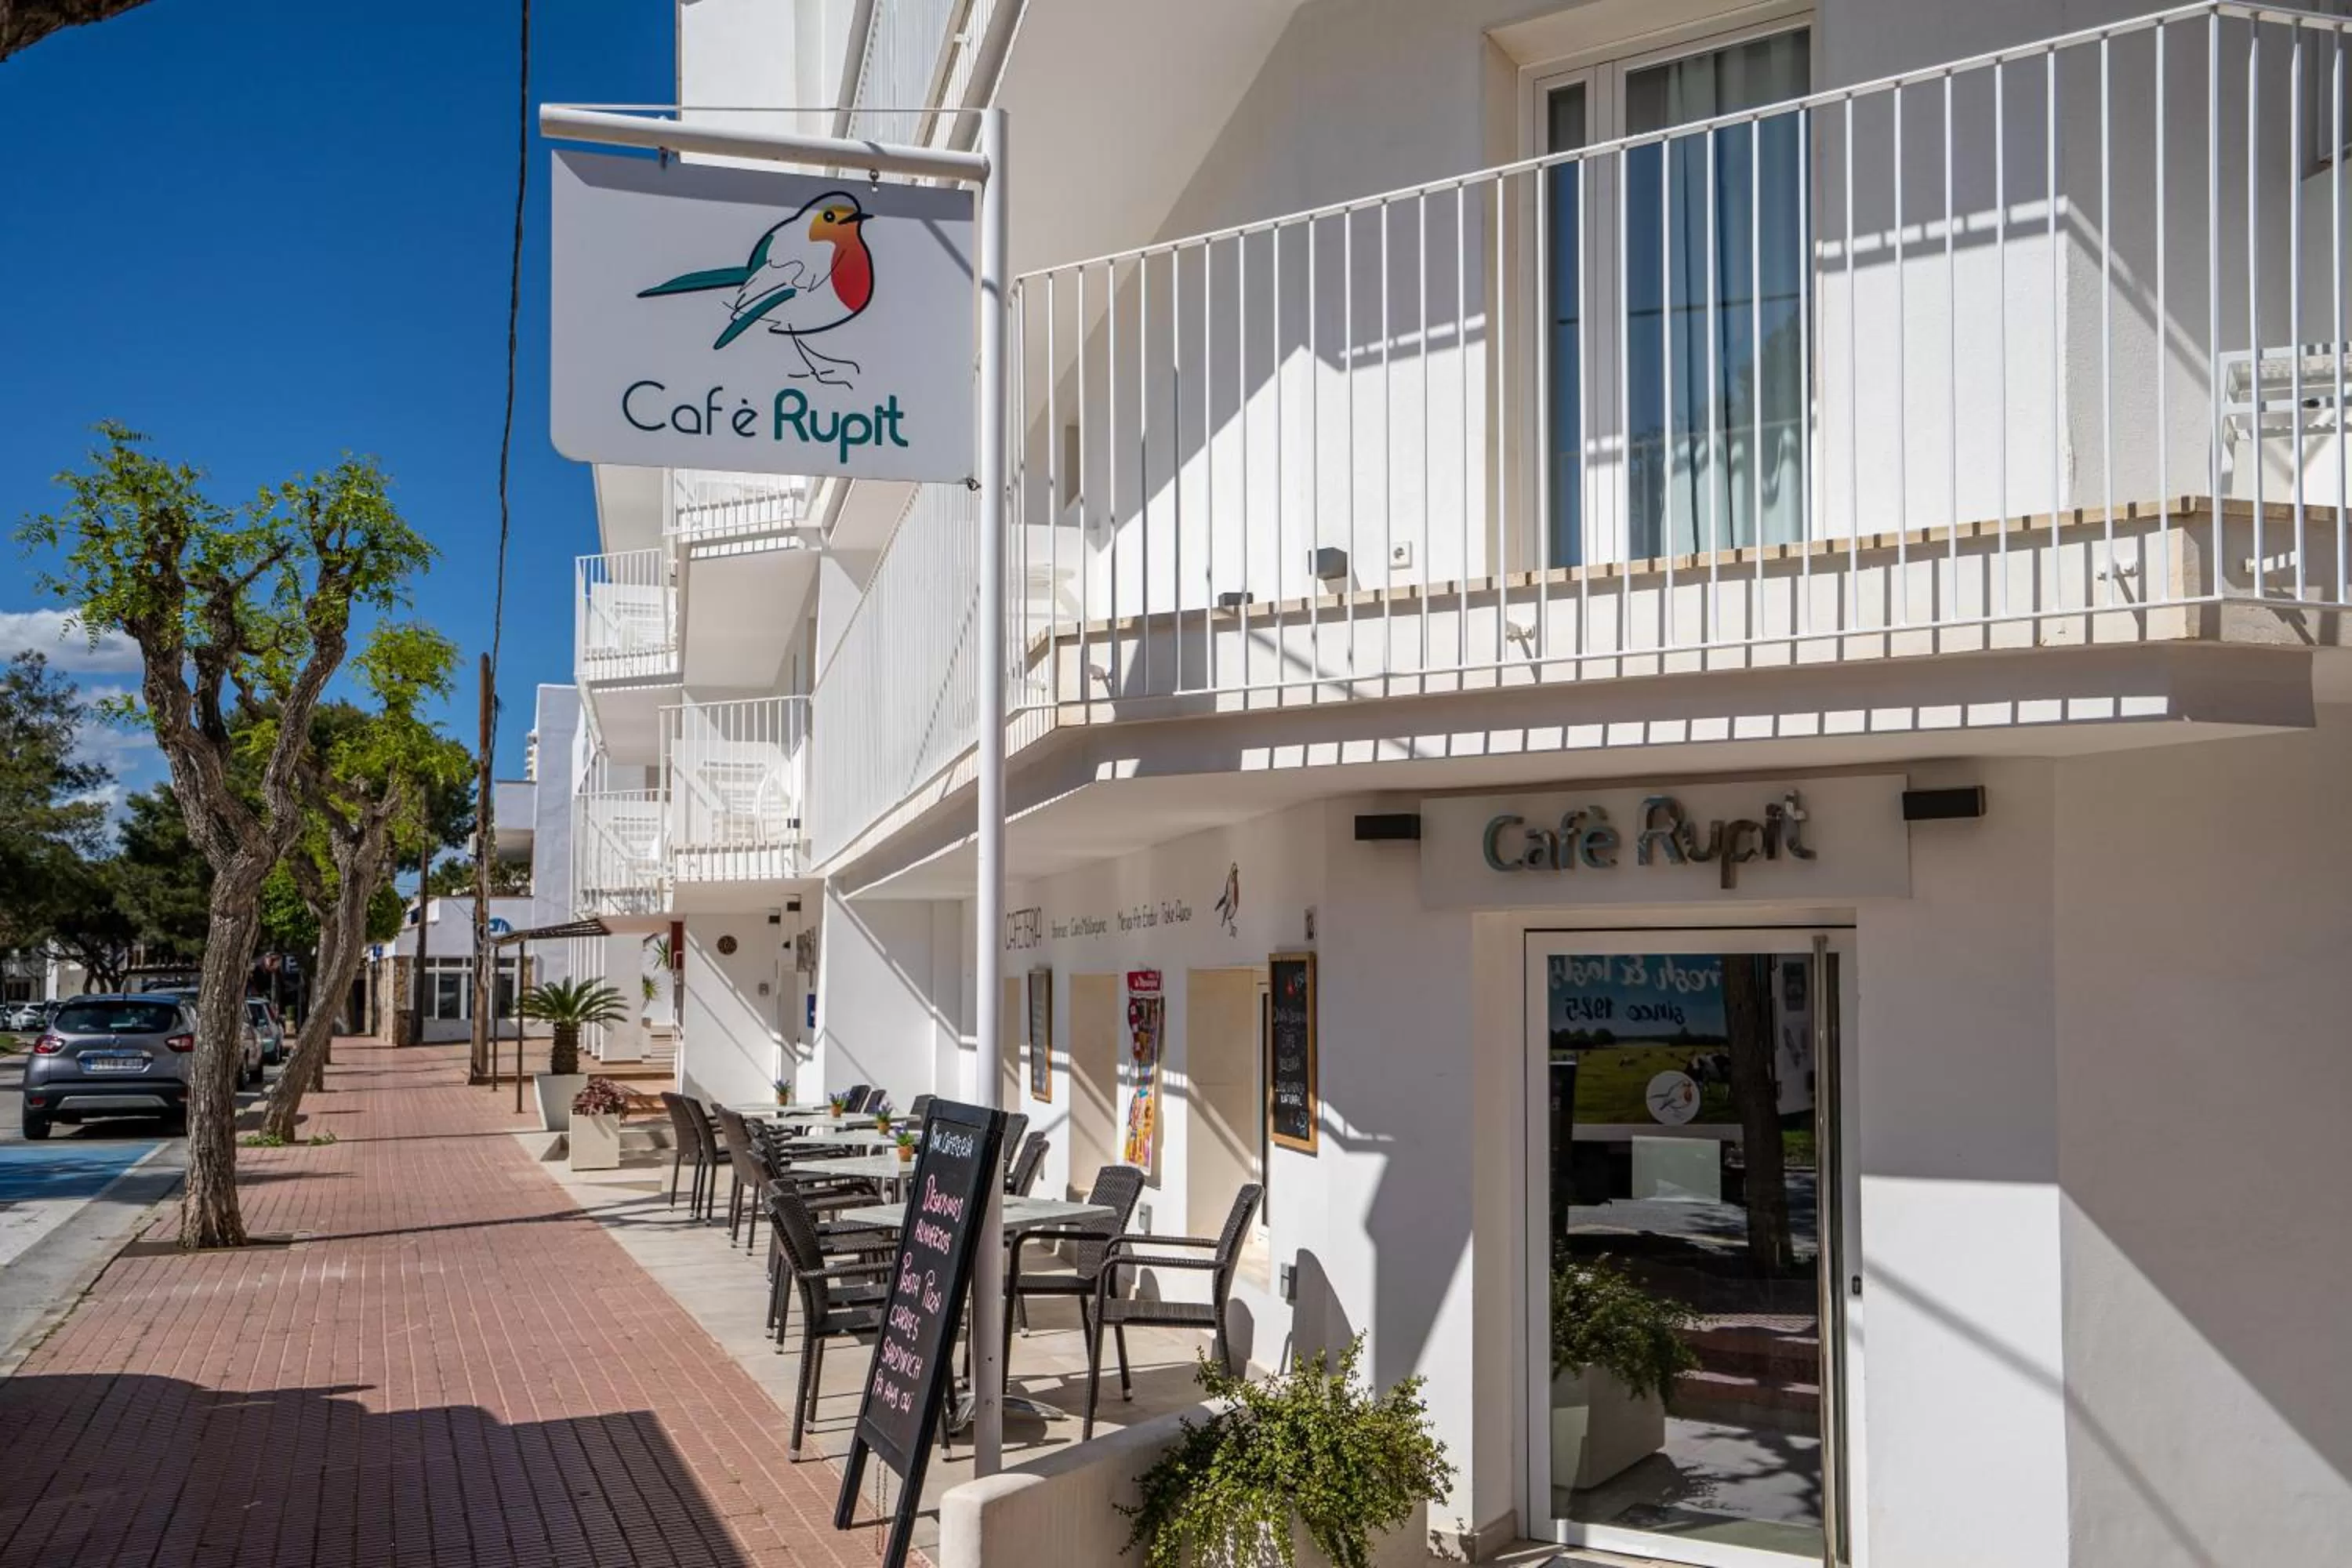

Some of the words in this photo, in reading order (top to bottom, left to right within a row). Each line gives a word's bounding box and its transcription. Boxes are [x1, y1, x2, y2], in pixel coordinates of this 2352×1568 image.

[622, 379, 757, 437] Cafè
[774, 388, 908, 463] Rupit
[1637, 789, 1817, 889] Rupit
